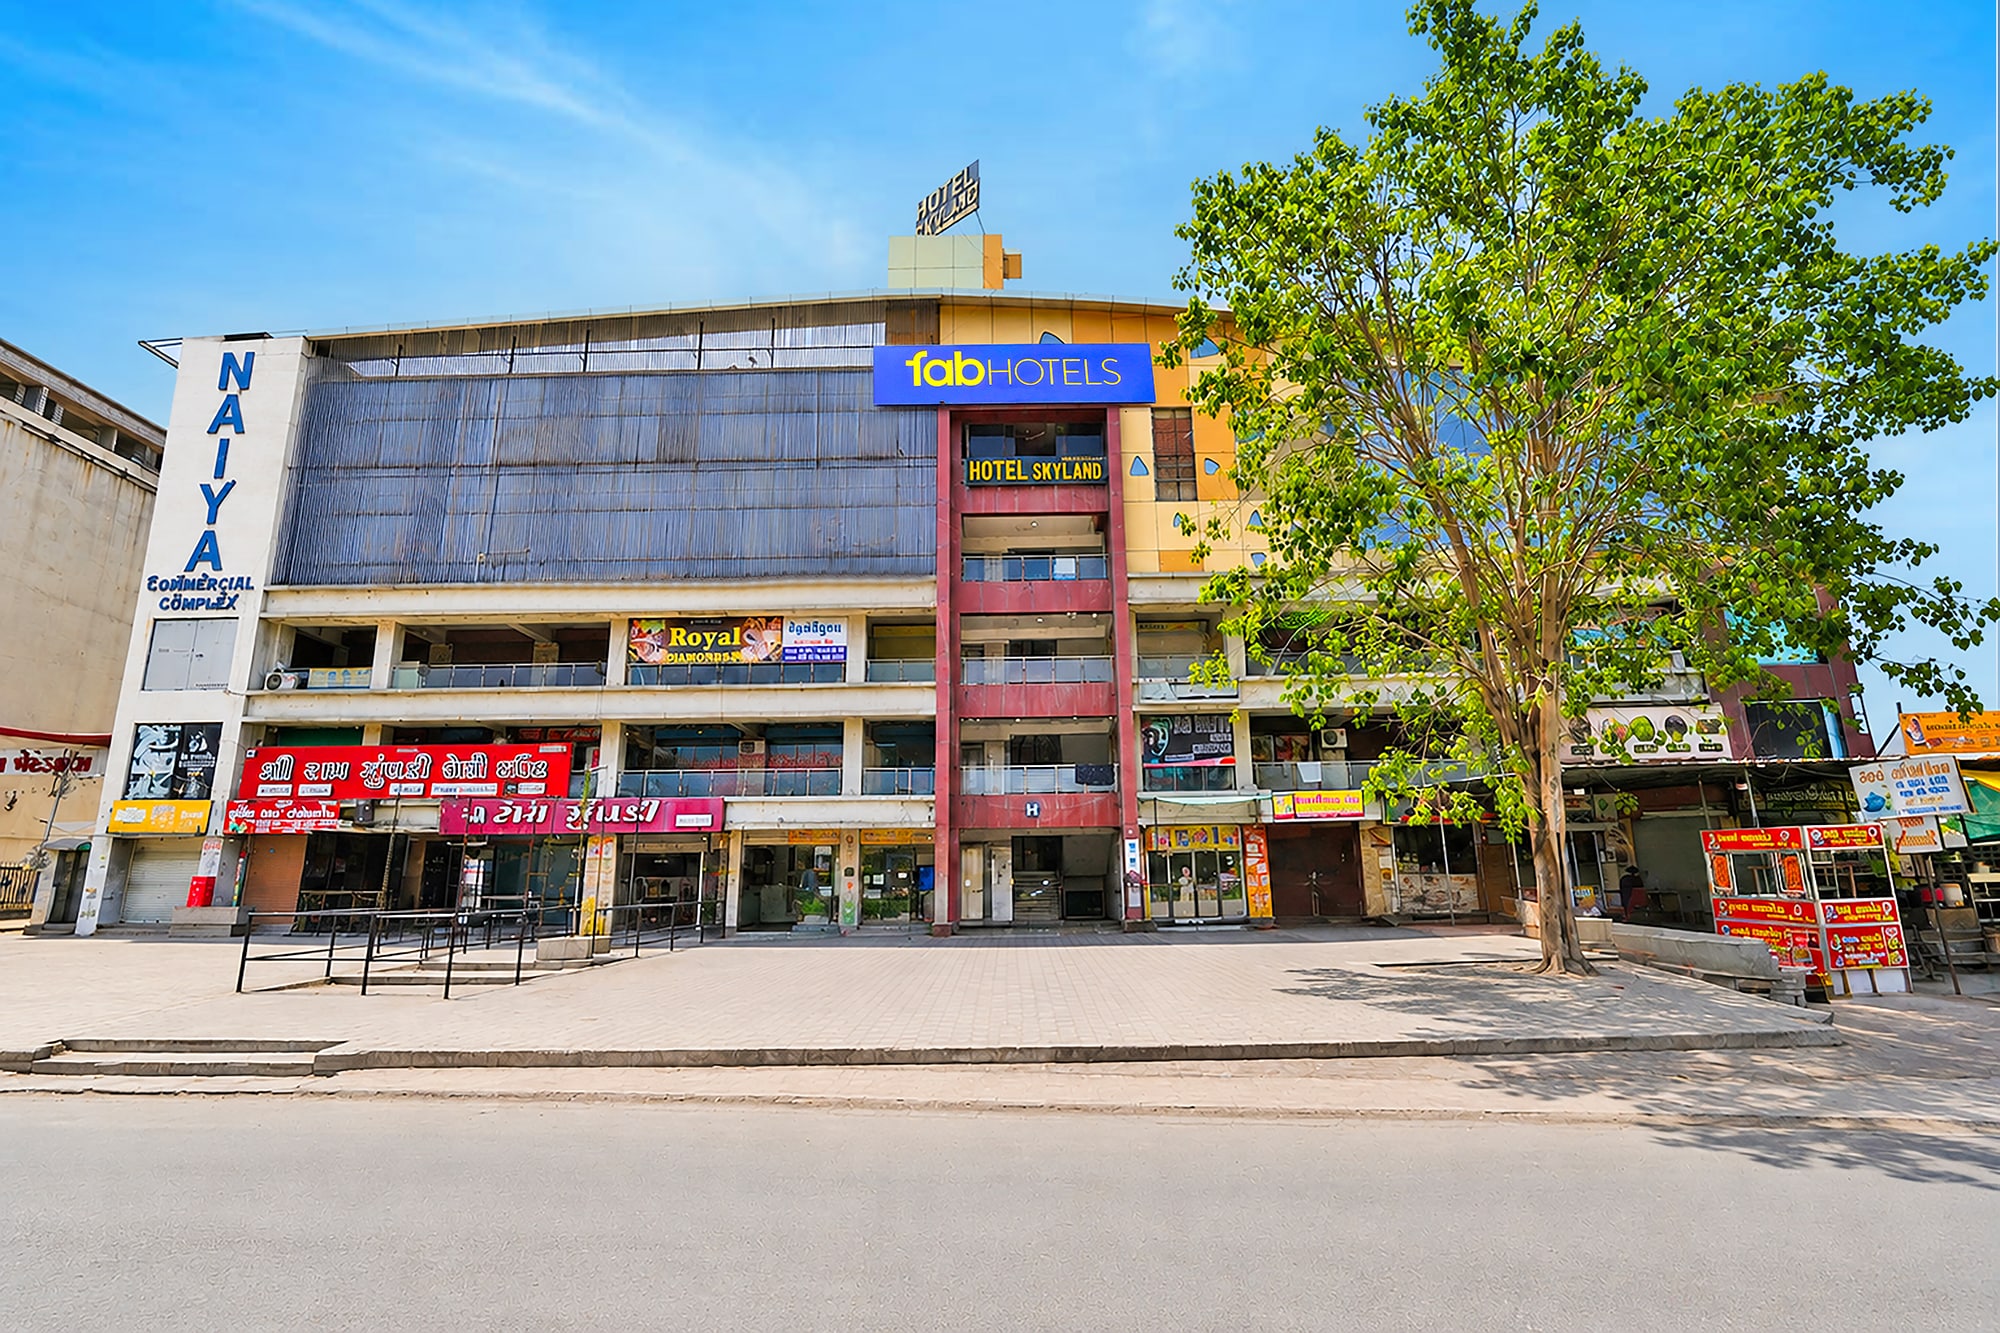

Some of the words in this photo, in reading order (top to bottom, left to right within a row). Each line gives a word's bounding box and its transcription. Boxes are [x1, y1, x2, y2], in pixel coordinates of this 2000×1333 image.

[917, 166, 973, 221] HOTEL
[184, 351, 255, 572] NAIYA
[969, 459, 1028, 480] HOTEL
[1032, 462, 1102, 480] SKYLAND
[147, 574, 255, 592] COMMERCIAL
[158, 592, 240, 611] COMPLEX
[669, 627, 741, 650] Royal
